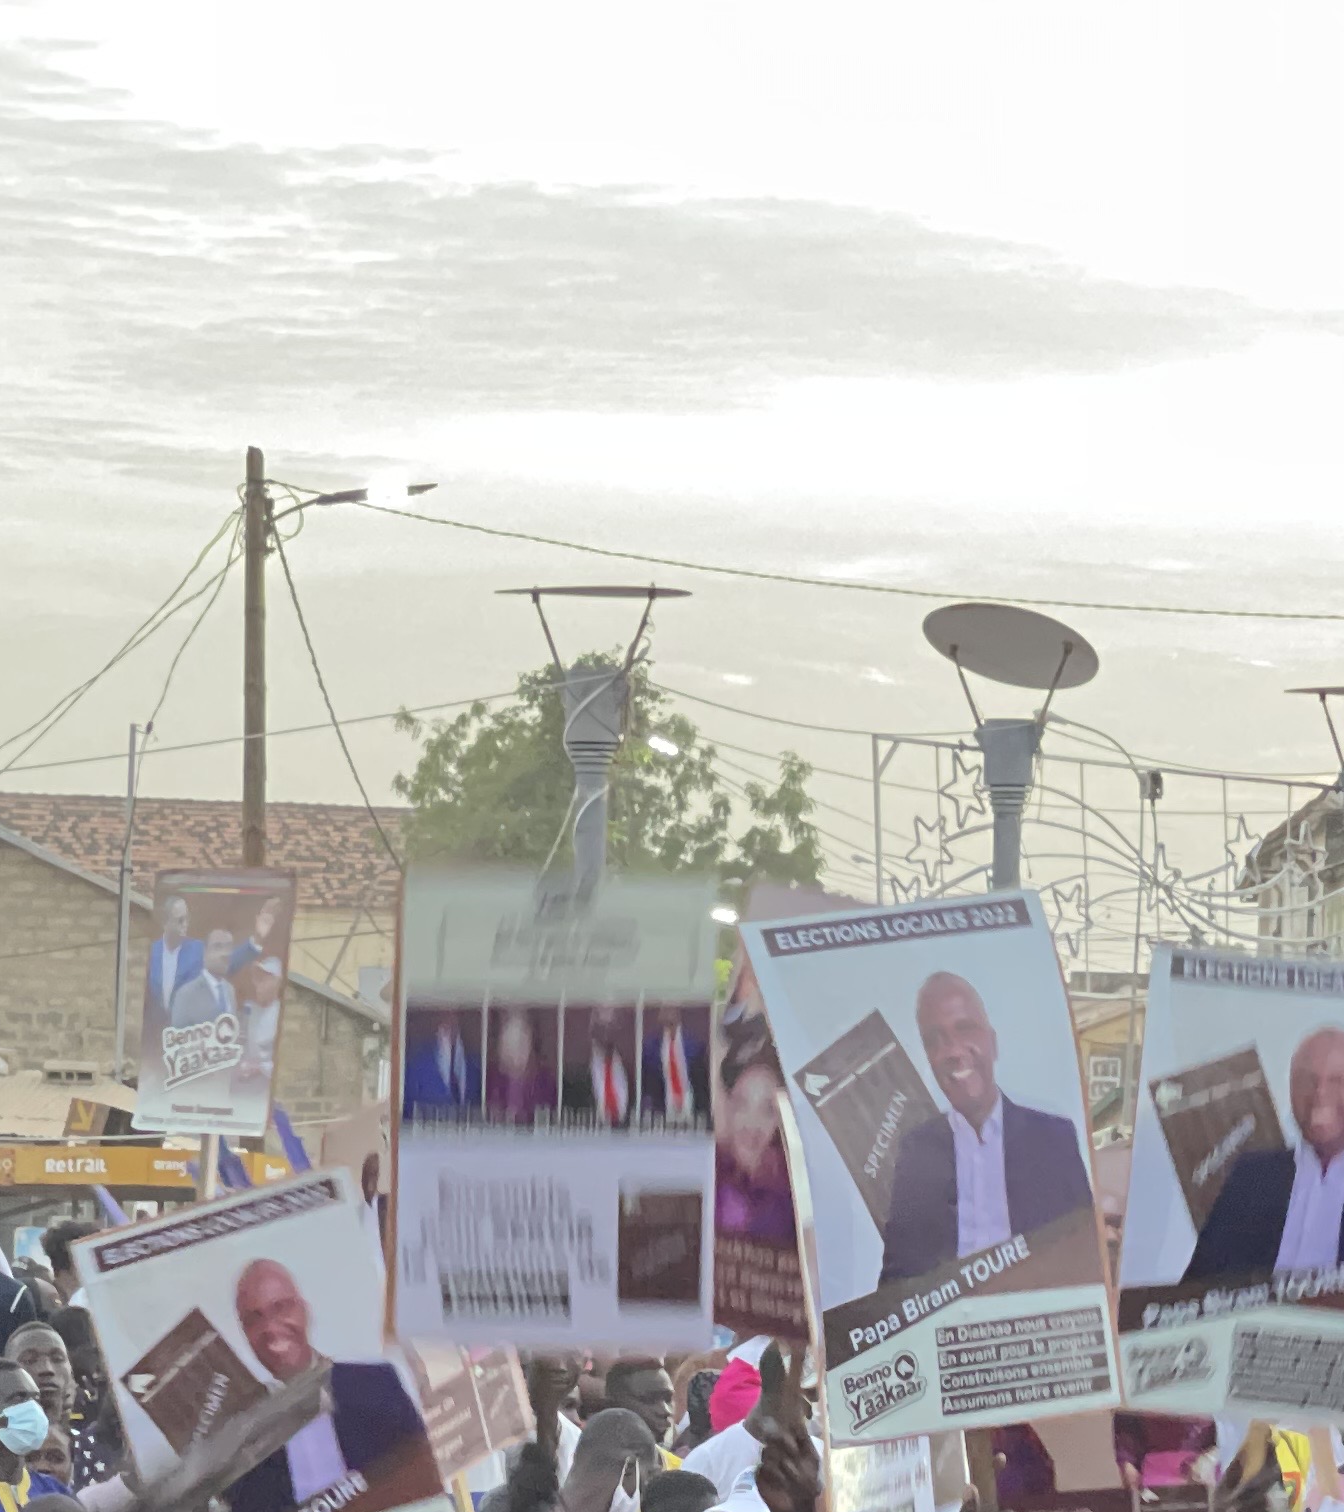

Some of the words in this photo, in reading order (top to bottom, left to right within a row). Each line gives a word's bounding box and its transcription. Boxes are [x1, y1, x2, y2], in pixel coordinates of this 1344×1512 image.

[777, 920, 882, 952] ELECTIONS
[884, 911, 969, 940] LOCALES
[971, 903, 1019, 928] 2022
[863, 1093, 909, 1179] SPECIMEN
[849, 1312, 901, 1351] Papa
[902, 1277, 963, 1324] Biram
[960, 1232, 1030, 1289] TOURE
[843, 1362, 892, 1395] Benno
[849, 1372, 924, 1419] Yaakaar
